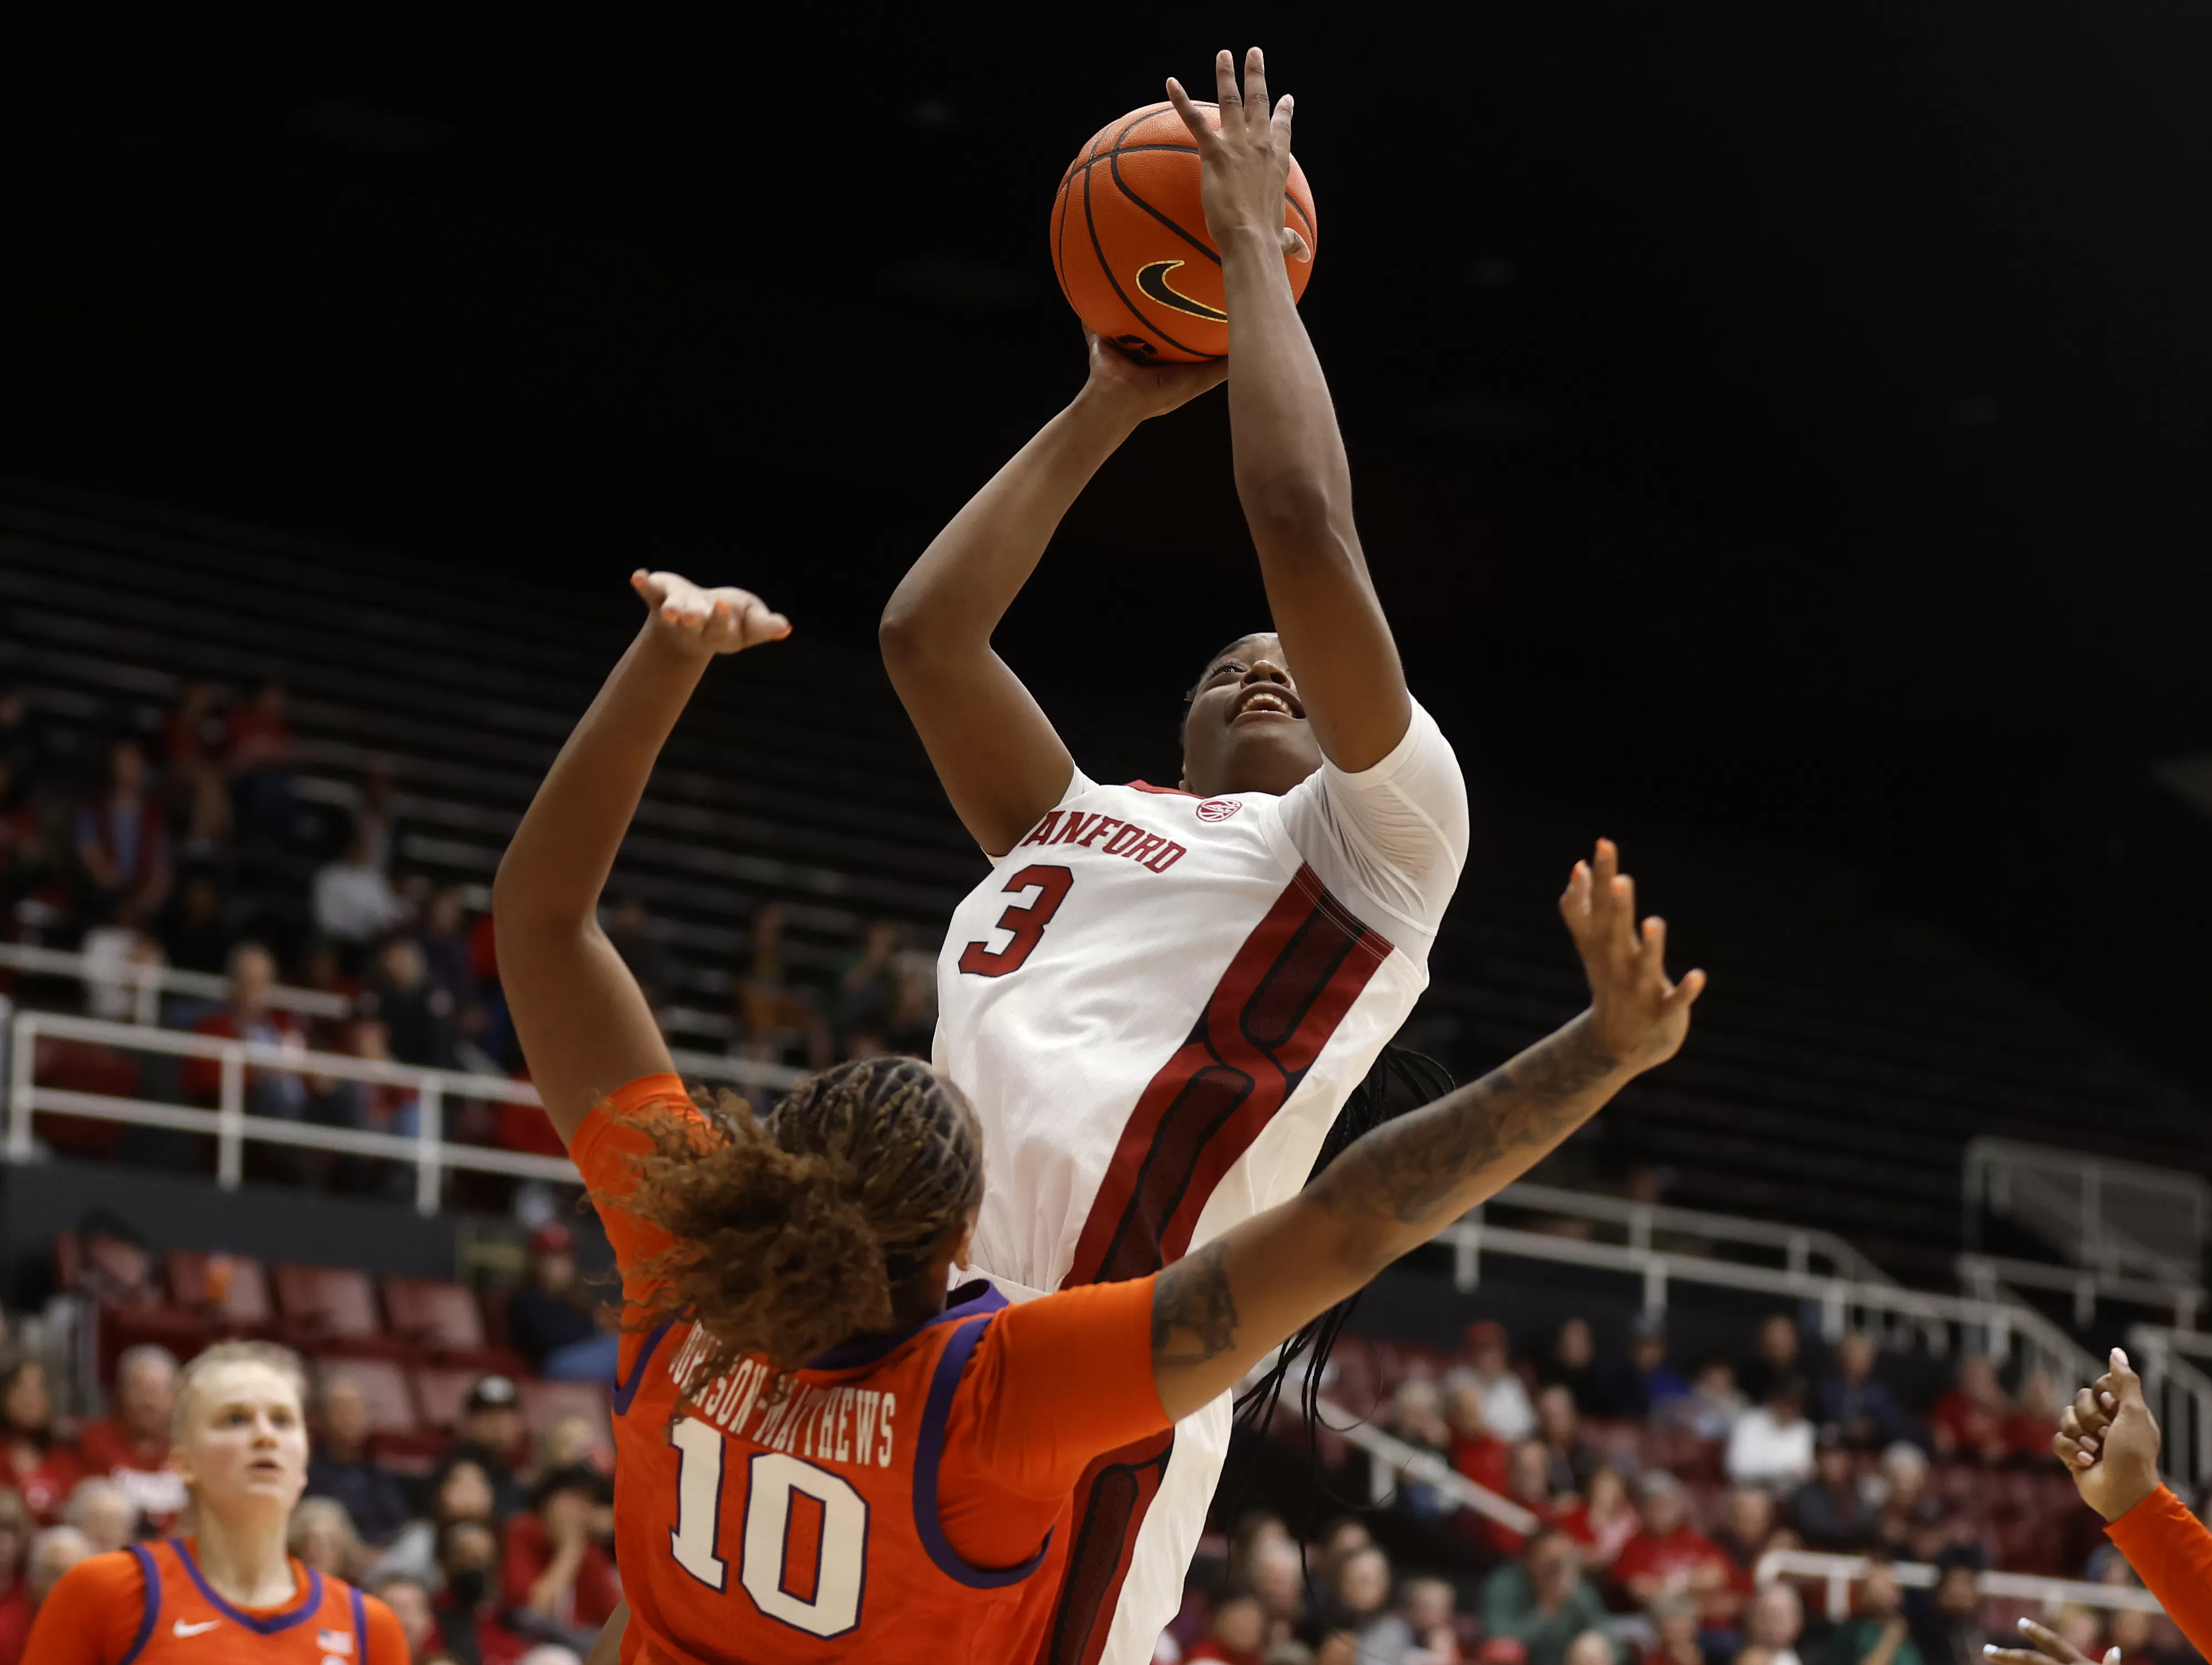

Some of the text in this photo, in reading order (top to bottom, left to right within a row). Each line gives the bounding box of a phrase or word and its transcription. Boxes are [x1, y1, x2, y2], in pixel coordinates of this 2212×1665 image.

[1020, 810, 1187, 873] ANFORD
[958, 864, 1074, 978] 3
[668, 1319, 896, 1468] OHSON-MATTHEWS
[670, 1416, 871, 1642] 10
